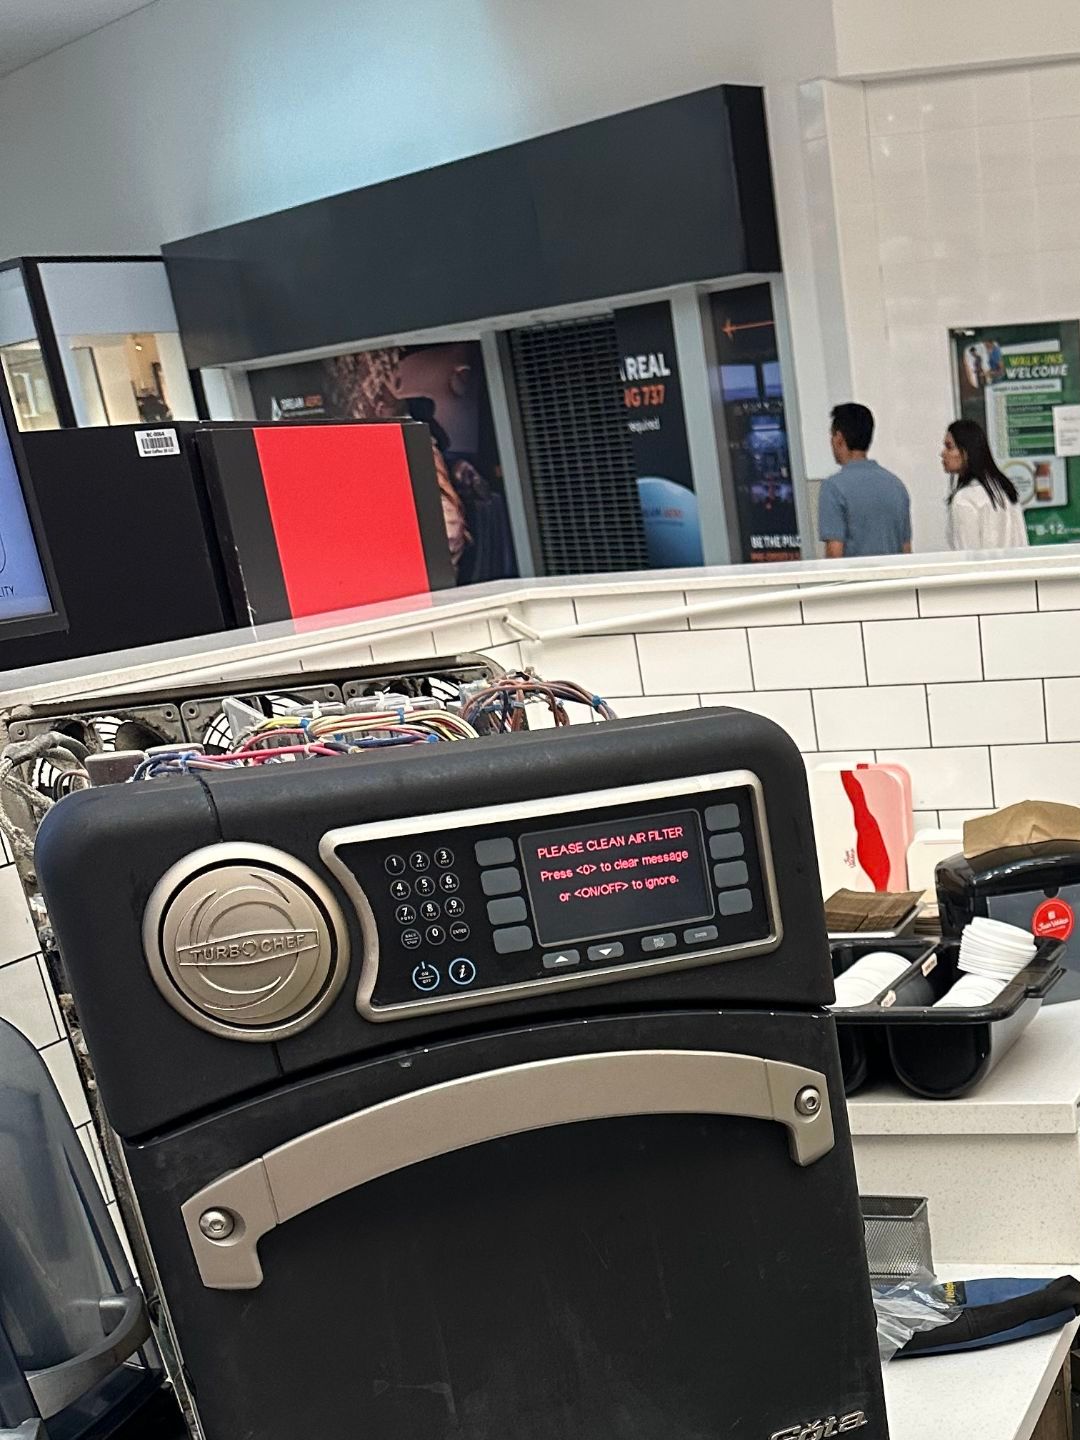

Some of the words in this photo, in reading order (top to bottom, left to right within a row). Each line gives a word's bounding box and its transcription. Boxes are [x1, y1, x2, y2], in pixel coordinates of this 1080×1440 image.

[1008, 353, 1064, 366] WALK-INS
[625, 352, 672, 381] REAL
[1005, 364, 1069, 379] WELCOME
[641, 384, 665, 407] 737
[537, 841, 584, 860] PLEASE
[586, 835, 626, 851] CLEAN
[627, 832, 646, 845] AIR
[647, 826, 684, 841] FILTER
[416, 854, 423, 864] 2
[440, 850, 448, 860] 3
[391, 858, 398, 867] 1
[540, 867, 573, 882] Press
[576, 863, 597, 876] <0>
[600, 861, 612, 873] to
[614, 856, 638, 870] clear
[641, 850, 689, 866] message
[421, 879, 428, 888] 5
[445, 876, 453, 885] 6
[396, 882, 403, 892] 4
[559, 891, 571, 902] or
[574, 881, 629, 898] <ON/OFF>
[632, 879, 643, 890] to
[645, 874, 680, 889] ignore.
[426, 903, 434, 913] 8
[450, 900, 458, 909] 9
[401, 907, 408, 917] 7
[432, 928, 439, 937] 0
[189, 934, 306, 961] TURBOCHEF
